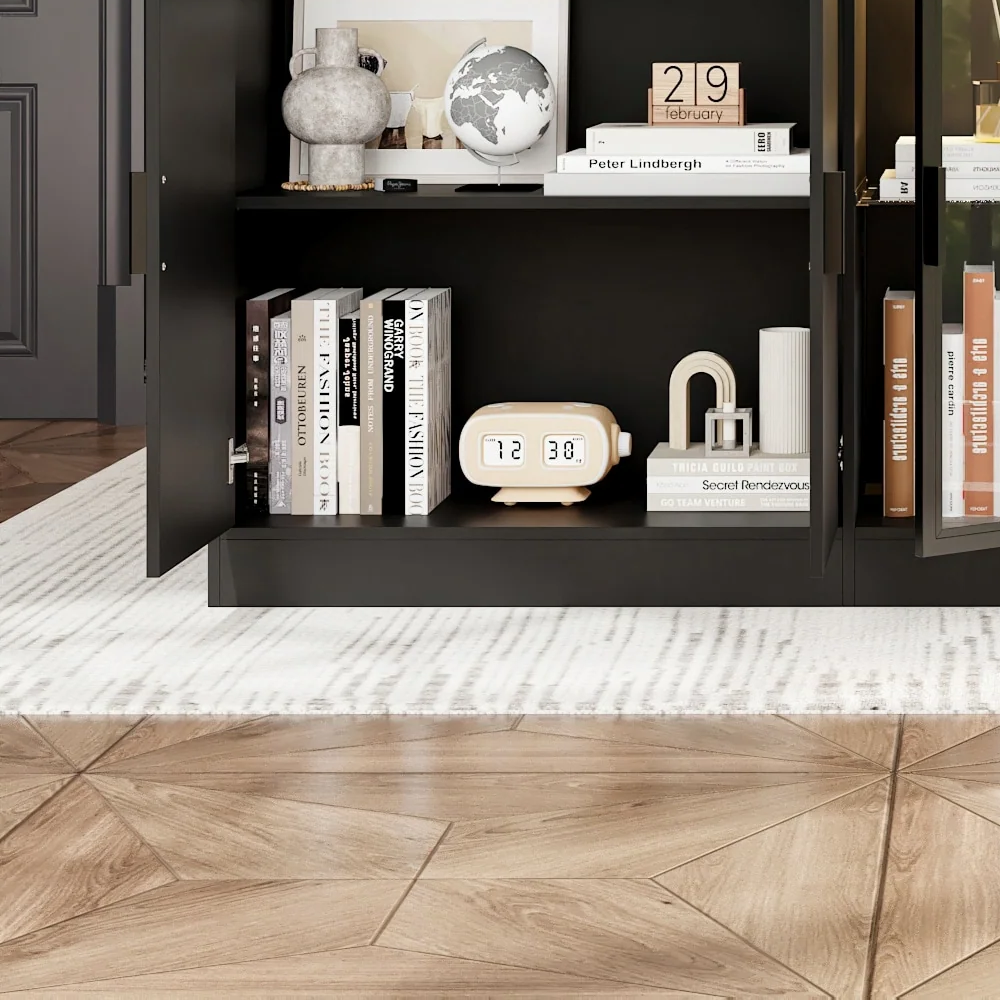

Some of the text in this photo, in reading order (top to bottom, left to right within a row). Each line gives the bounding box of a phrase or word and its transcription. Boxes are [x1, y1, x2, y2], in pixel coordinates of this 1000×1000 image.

[665, 106, 724, 123] february
[757, 131, 766, 152] EERO
[589, 159, 702, 172] Peter Lindbergh
[394, 318, 404, 360] GARRY
[384, 318, 394, 393] WINOGRAND
[947, 351, 956, 381] pierre
[298, 365, 307, 446] OTTOBEUREN
[319, 302, 330, 511] THE FASHION BOOK
[409, 325, 425, 481] BOOK THE FASHION
[497, 441, 574, 460] 12 30
[673, 462, 798, 473] TRICIA GUILD PAINT BOX
[702, 480, 738, 491] Secret
[741, 480, 810, 491] Rendezvous
[661, 499, 746, 507] GO TEAM VENTURE
